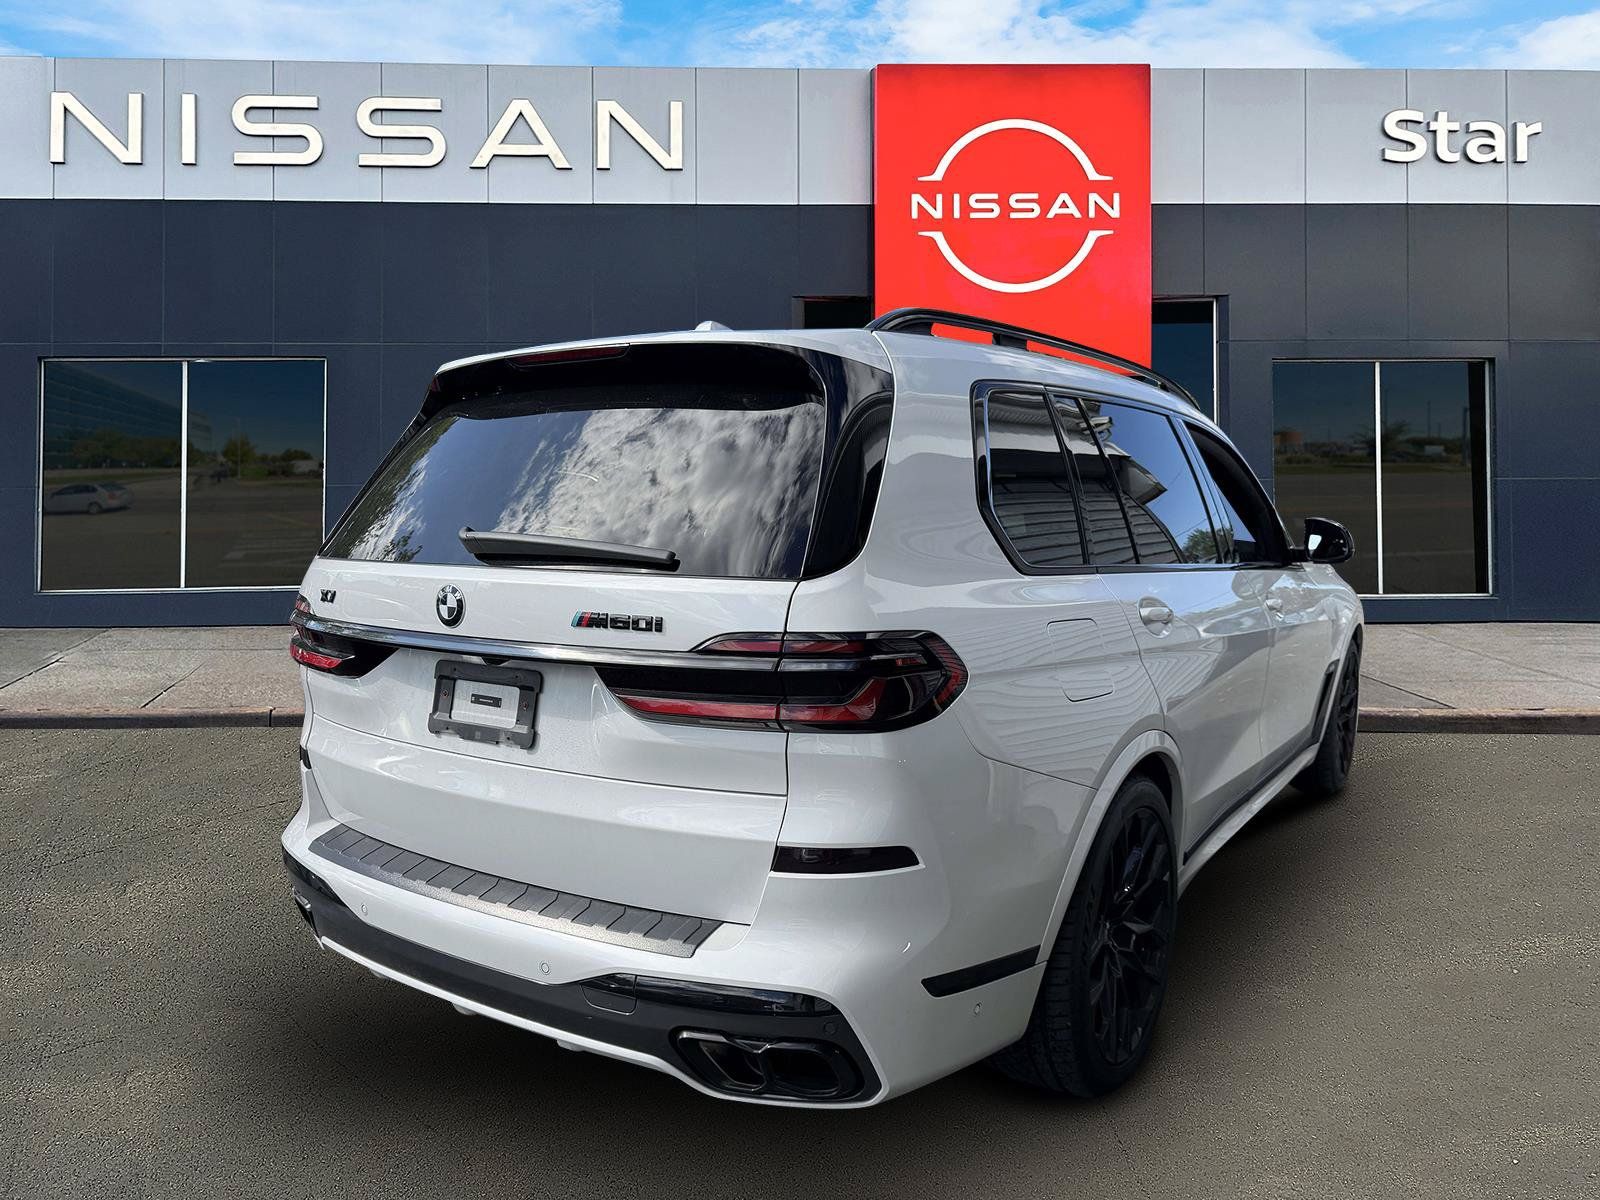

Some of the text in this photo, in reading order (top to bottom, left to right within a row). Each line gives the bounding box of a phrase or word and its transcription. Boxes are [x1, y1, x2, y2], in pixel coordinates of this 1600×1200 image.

[49, 91, 684, 170] NISSAN
[1381, 109, 1543, 164] Star
[911, 193, 1120, 220] NISSAN
